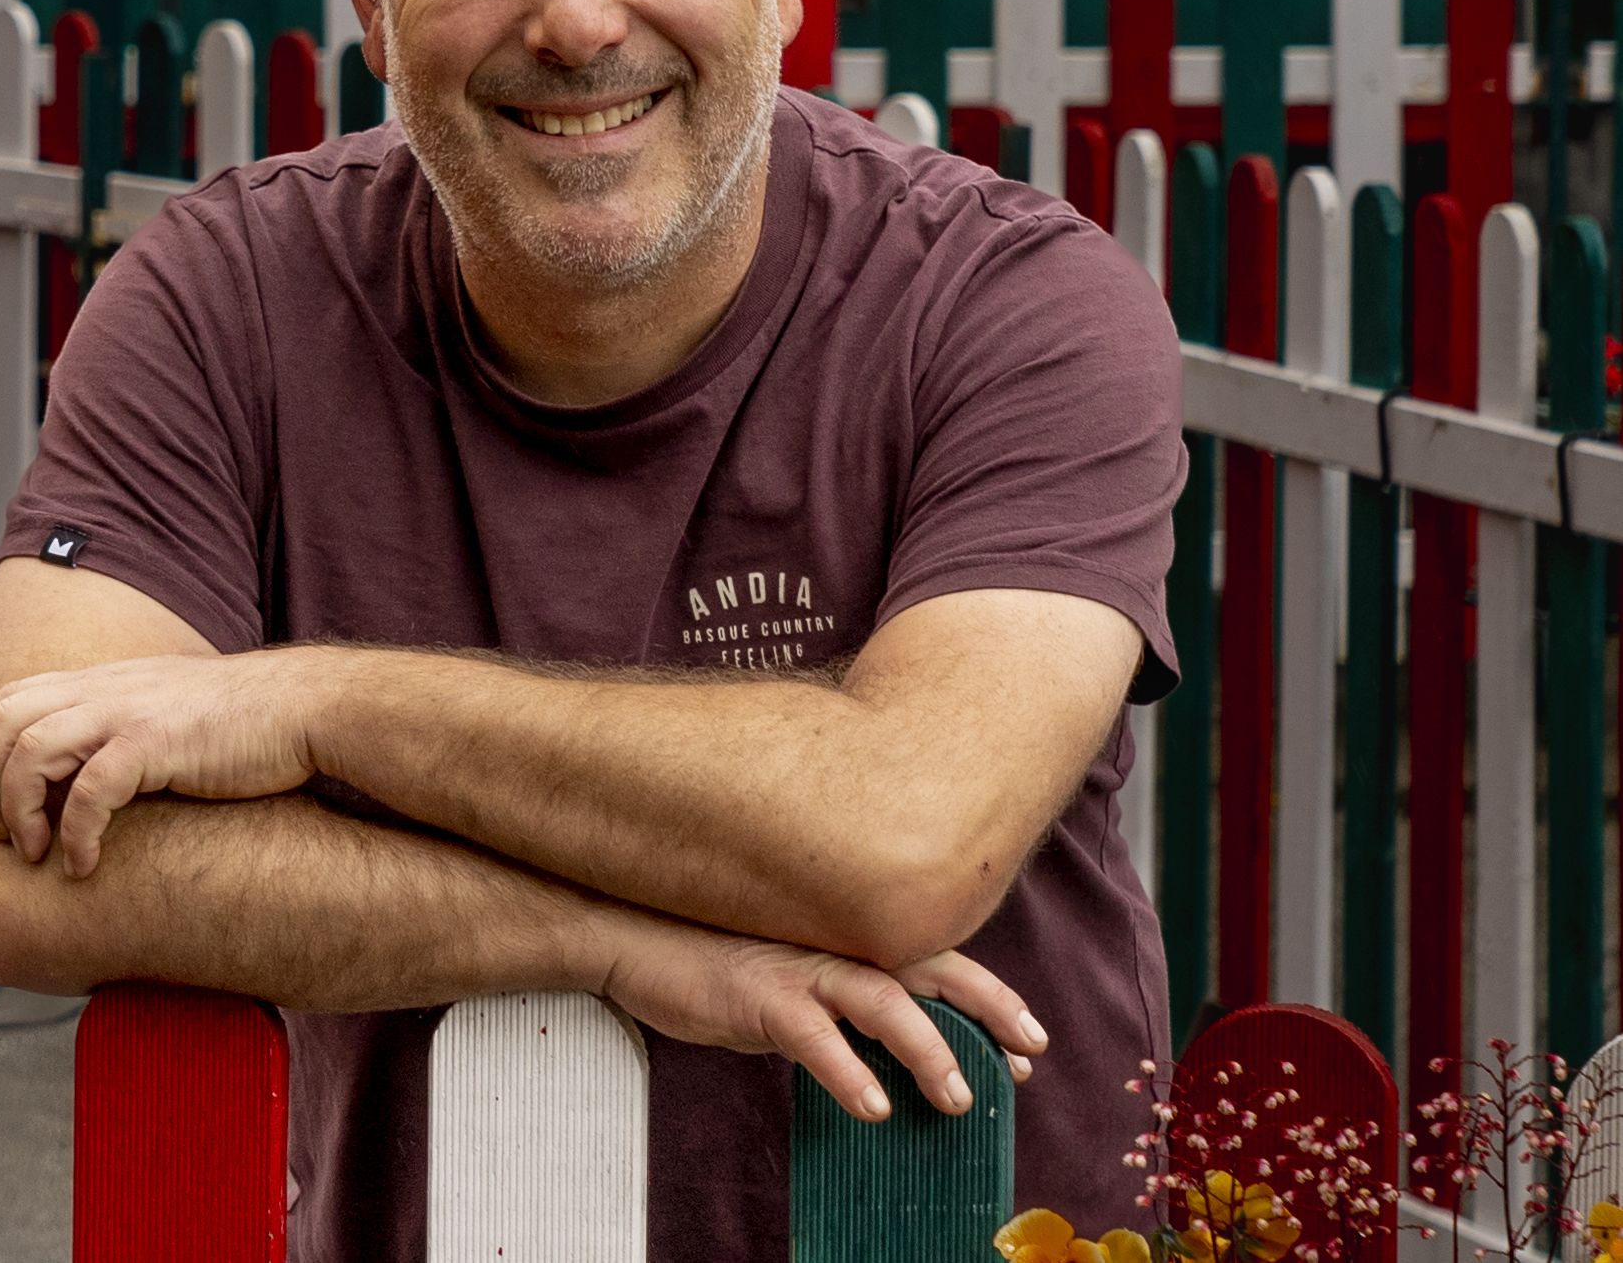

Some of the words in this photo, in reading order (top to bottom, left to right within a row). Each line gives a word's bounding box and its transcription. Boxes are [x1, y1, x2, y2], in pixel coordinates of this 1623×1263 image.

[688, 571, 812, 621] ANDIA
[683, 623, 750, 645] BASQUE
[761, 615, 835, 637] COUNTRY
[721, 643, 803, 670] FEELING
